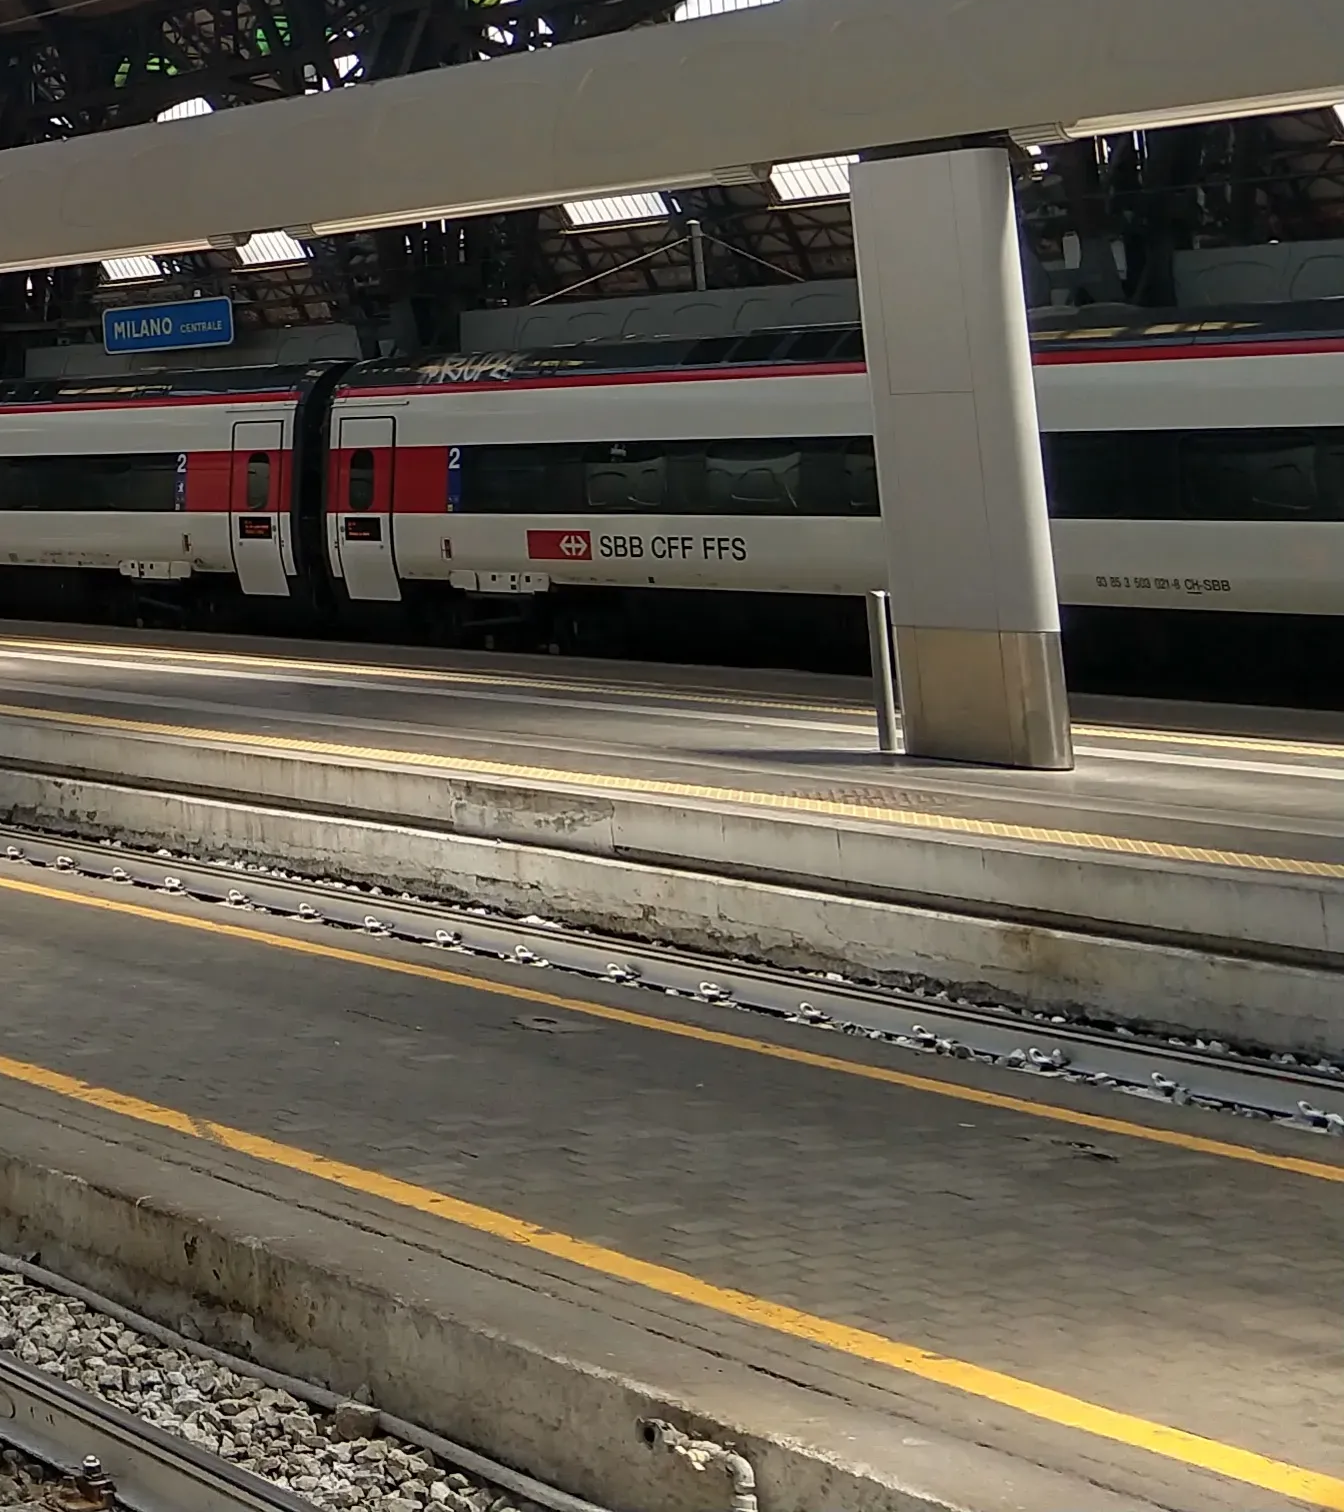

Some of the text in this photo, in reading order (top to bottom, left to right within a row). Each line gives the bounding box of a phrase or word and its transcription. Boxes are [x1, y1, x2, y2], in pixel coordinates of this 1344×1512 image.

[113, 317, 223, 340] MILANO CENTRALE
[177, 454, 187, 472] 2
[448, 447, 460, 469] 2
[600, 535, 746, 561] SBB CFF FFS
[1184, 579, 1231, 591] CH-SBB
